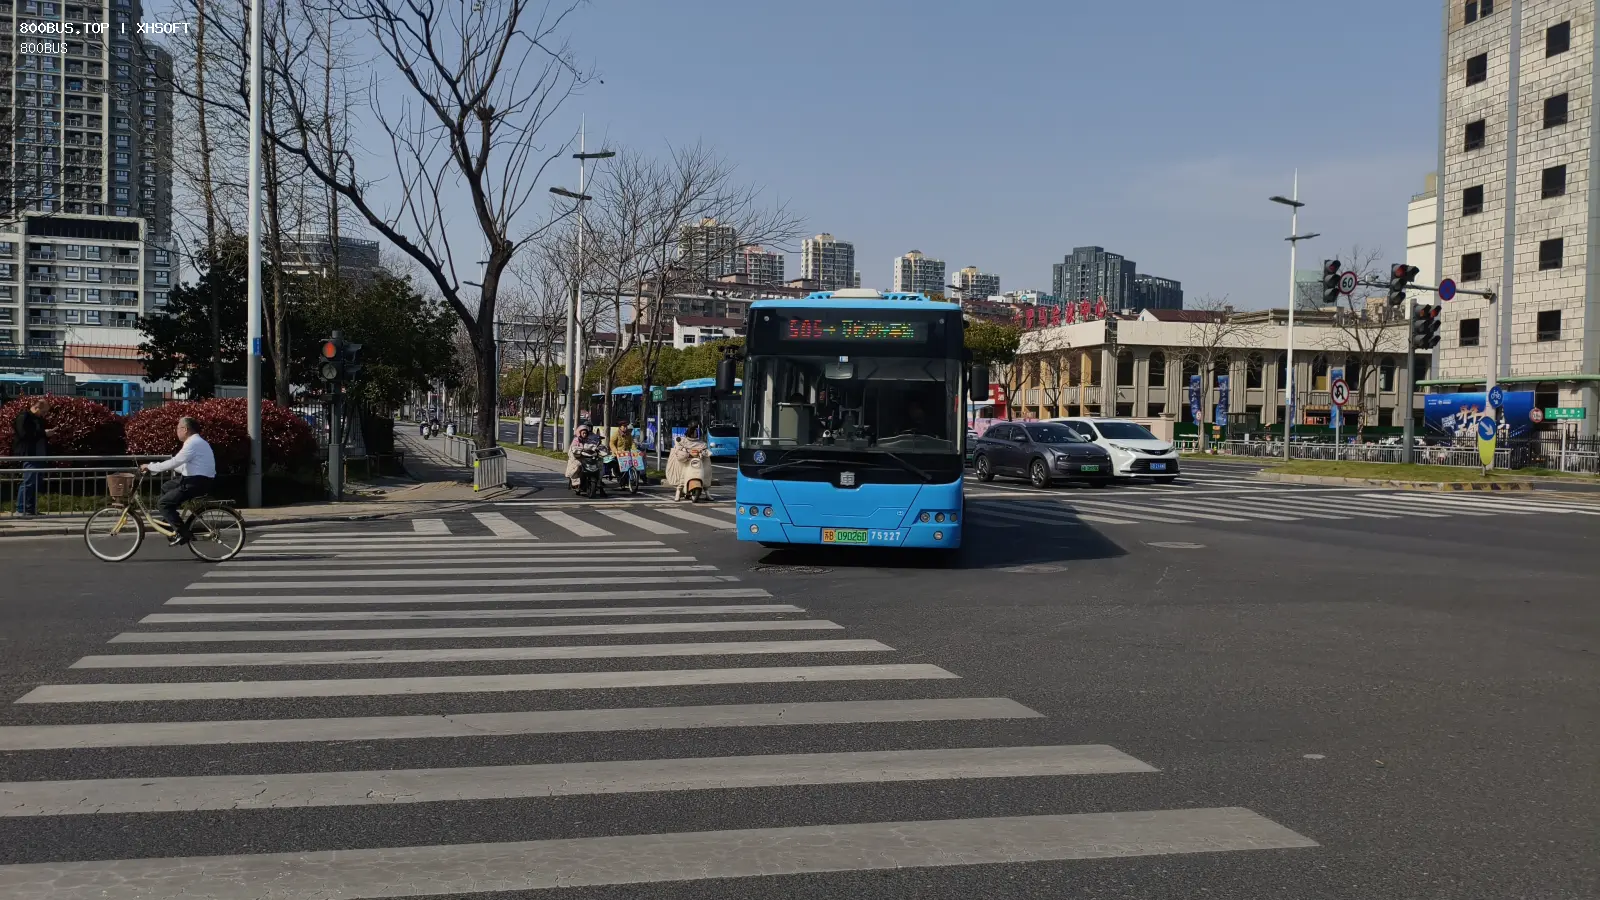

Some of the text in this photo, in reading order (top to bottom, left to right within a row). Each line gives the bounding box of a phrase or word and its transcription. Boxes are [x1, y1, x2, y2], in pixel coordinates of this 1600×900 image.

[1342, 276, 1353, 288] 60
[789, 319, 823, 338] 505
[871, 531, 900, 540] 75227
